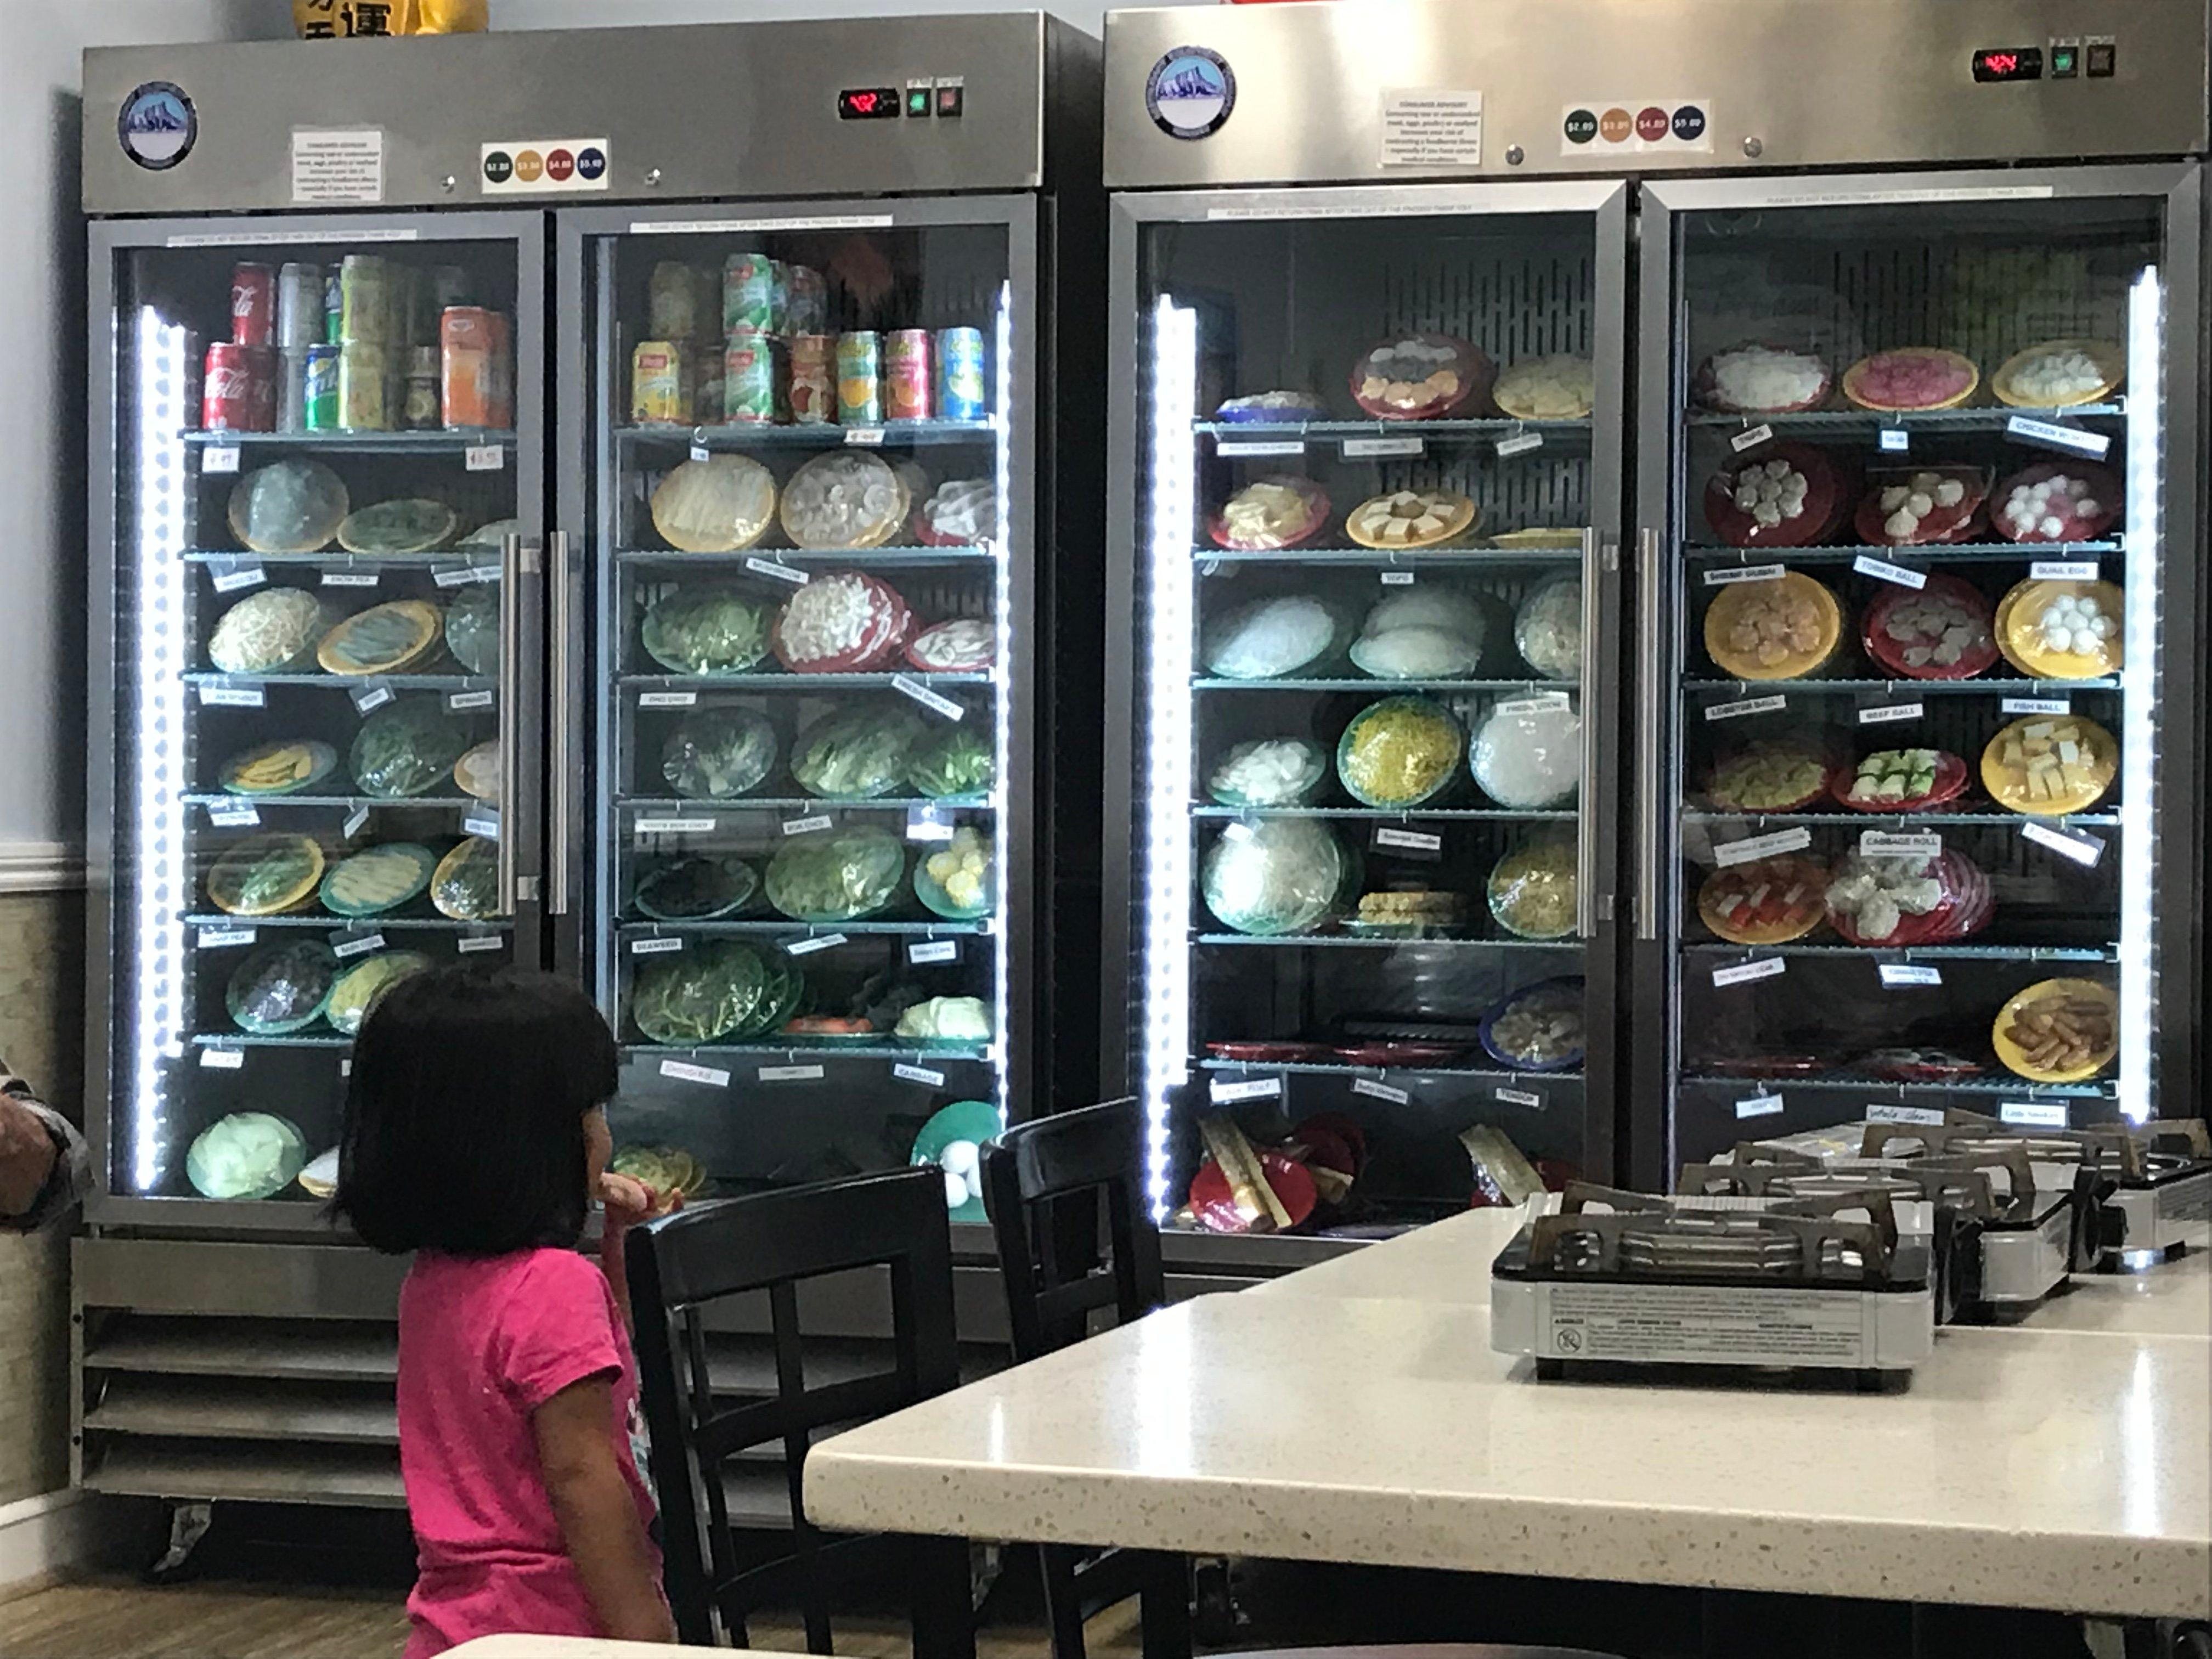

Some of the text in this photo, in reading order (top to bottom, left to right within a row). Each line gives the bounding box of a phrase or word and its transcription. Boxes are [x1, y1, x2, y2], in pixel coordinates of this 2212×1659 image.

[2016, 421, 2056, 437] CHICKEN
[2037, 567, 2064, 575] QUAIL
[1895, 570, 1917, 583] BALL
[1892, 708, 1915, 716] BALL
[2014, 703, 2061, 712] FISH BALL
[1866, 837, 1938, 845] CABBAGE ROLL
[636, 941, 678, 950] SEAWEED
